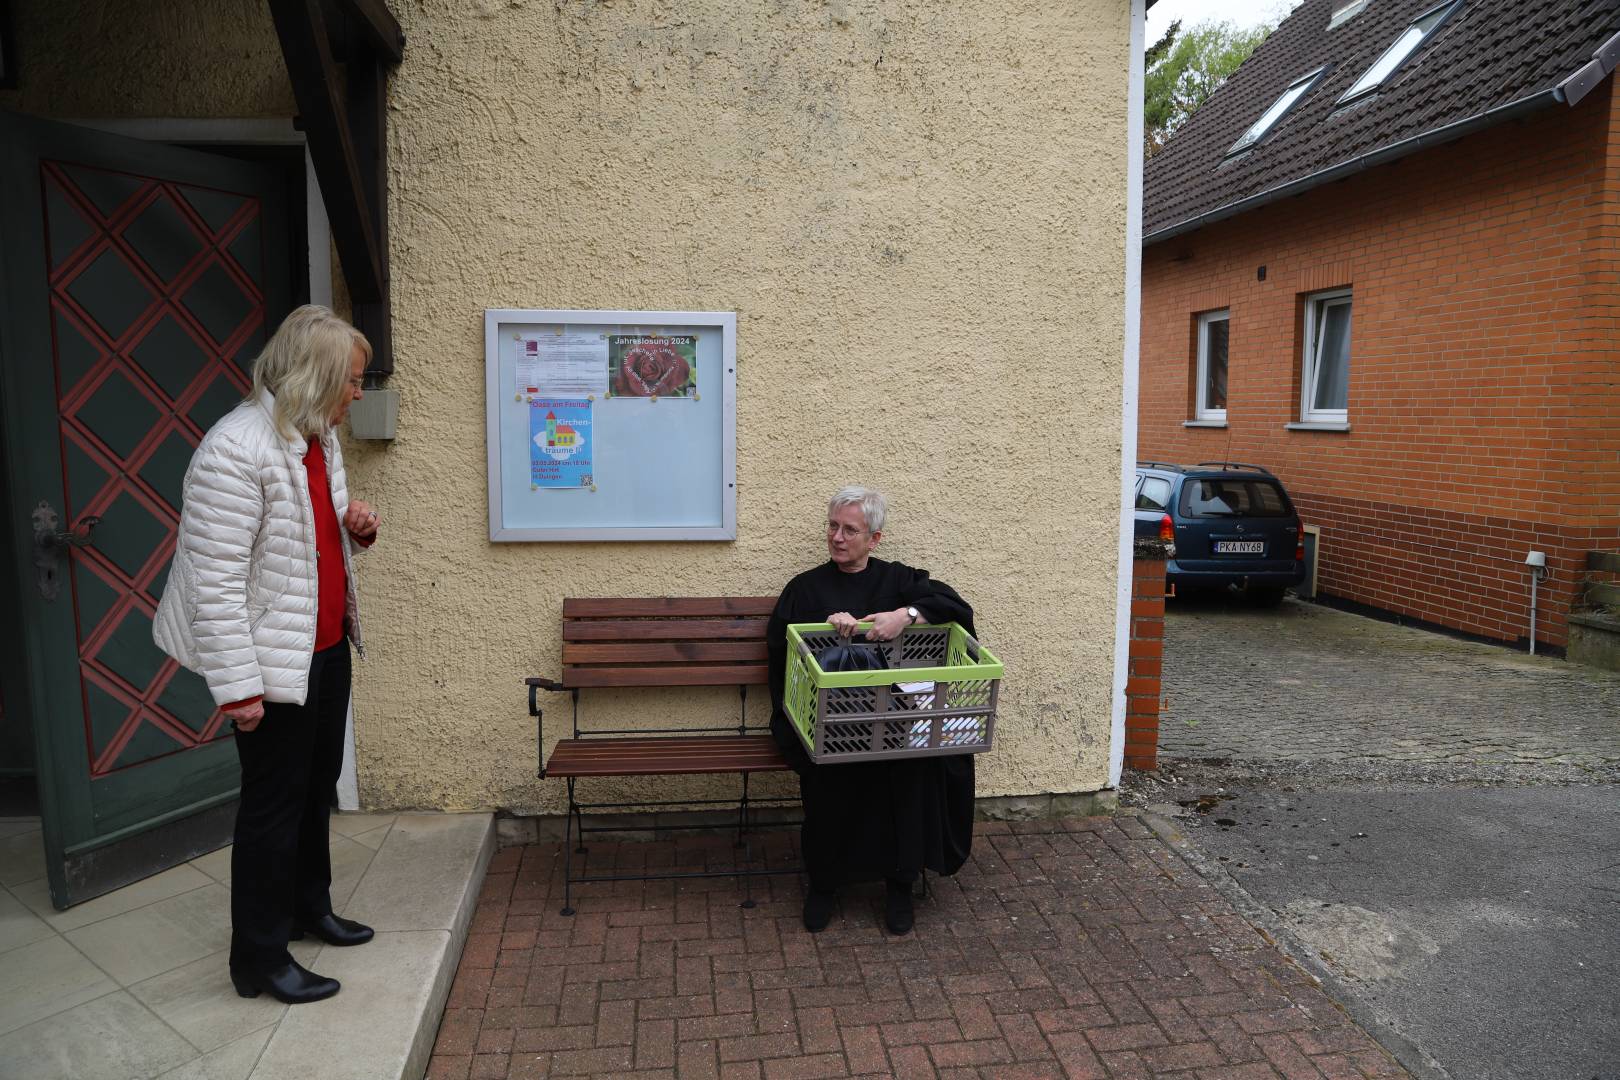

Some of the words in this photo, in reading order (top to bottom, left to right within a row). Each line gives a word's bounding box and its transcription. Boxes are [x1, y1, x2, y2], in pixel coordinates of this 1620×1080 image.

[614, 337, 669, 346] Jahreslosung
[671, 337, 690, 345] 2024
[565, 400, 590, 409] Freitag
[1219, 542, 1237, 552] PKA
[1239, 542, 1262, 552] NY68
